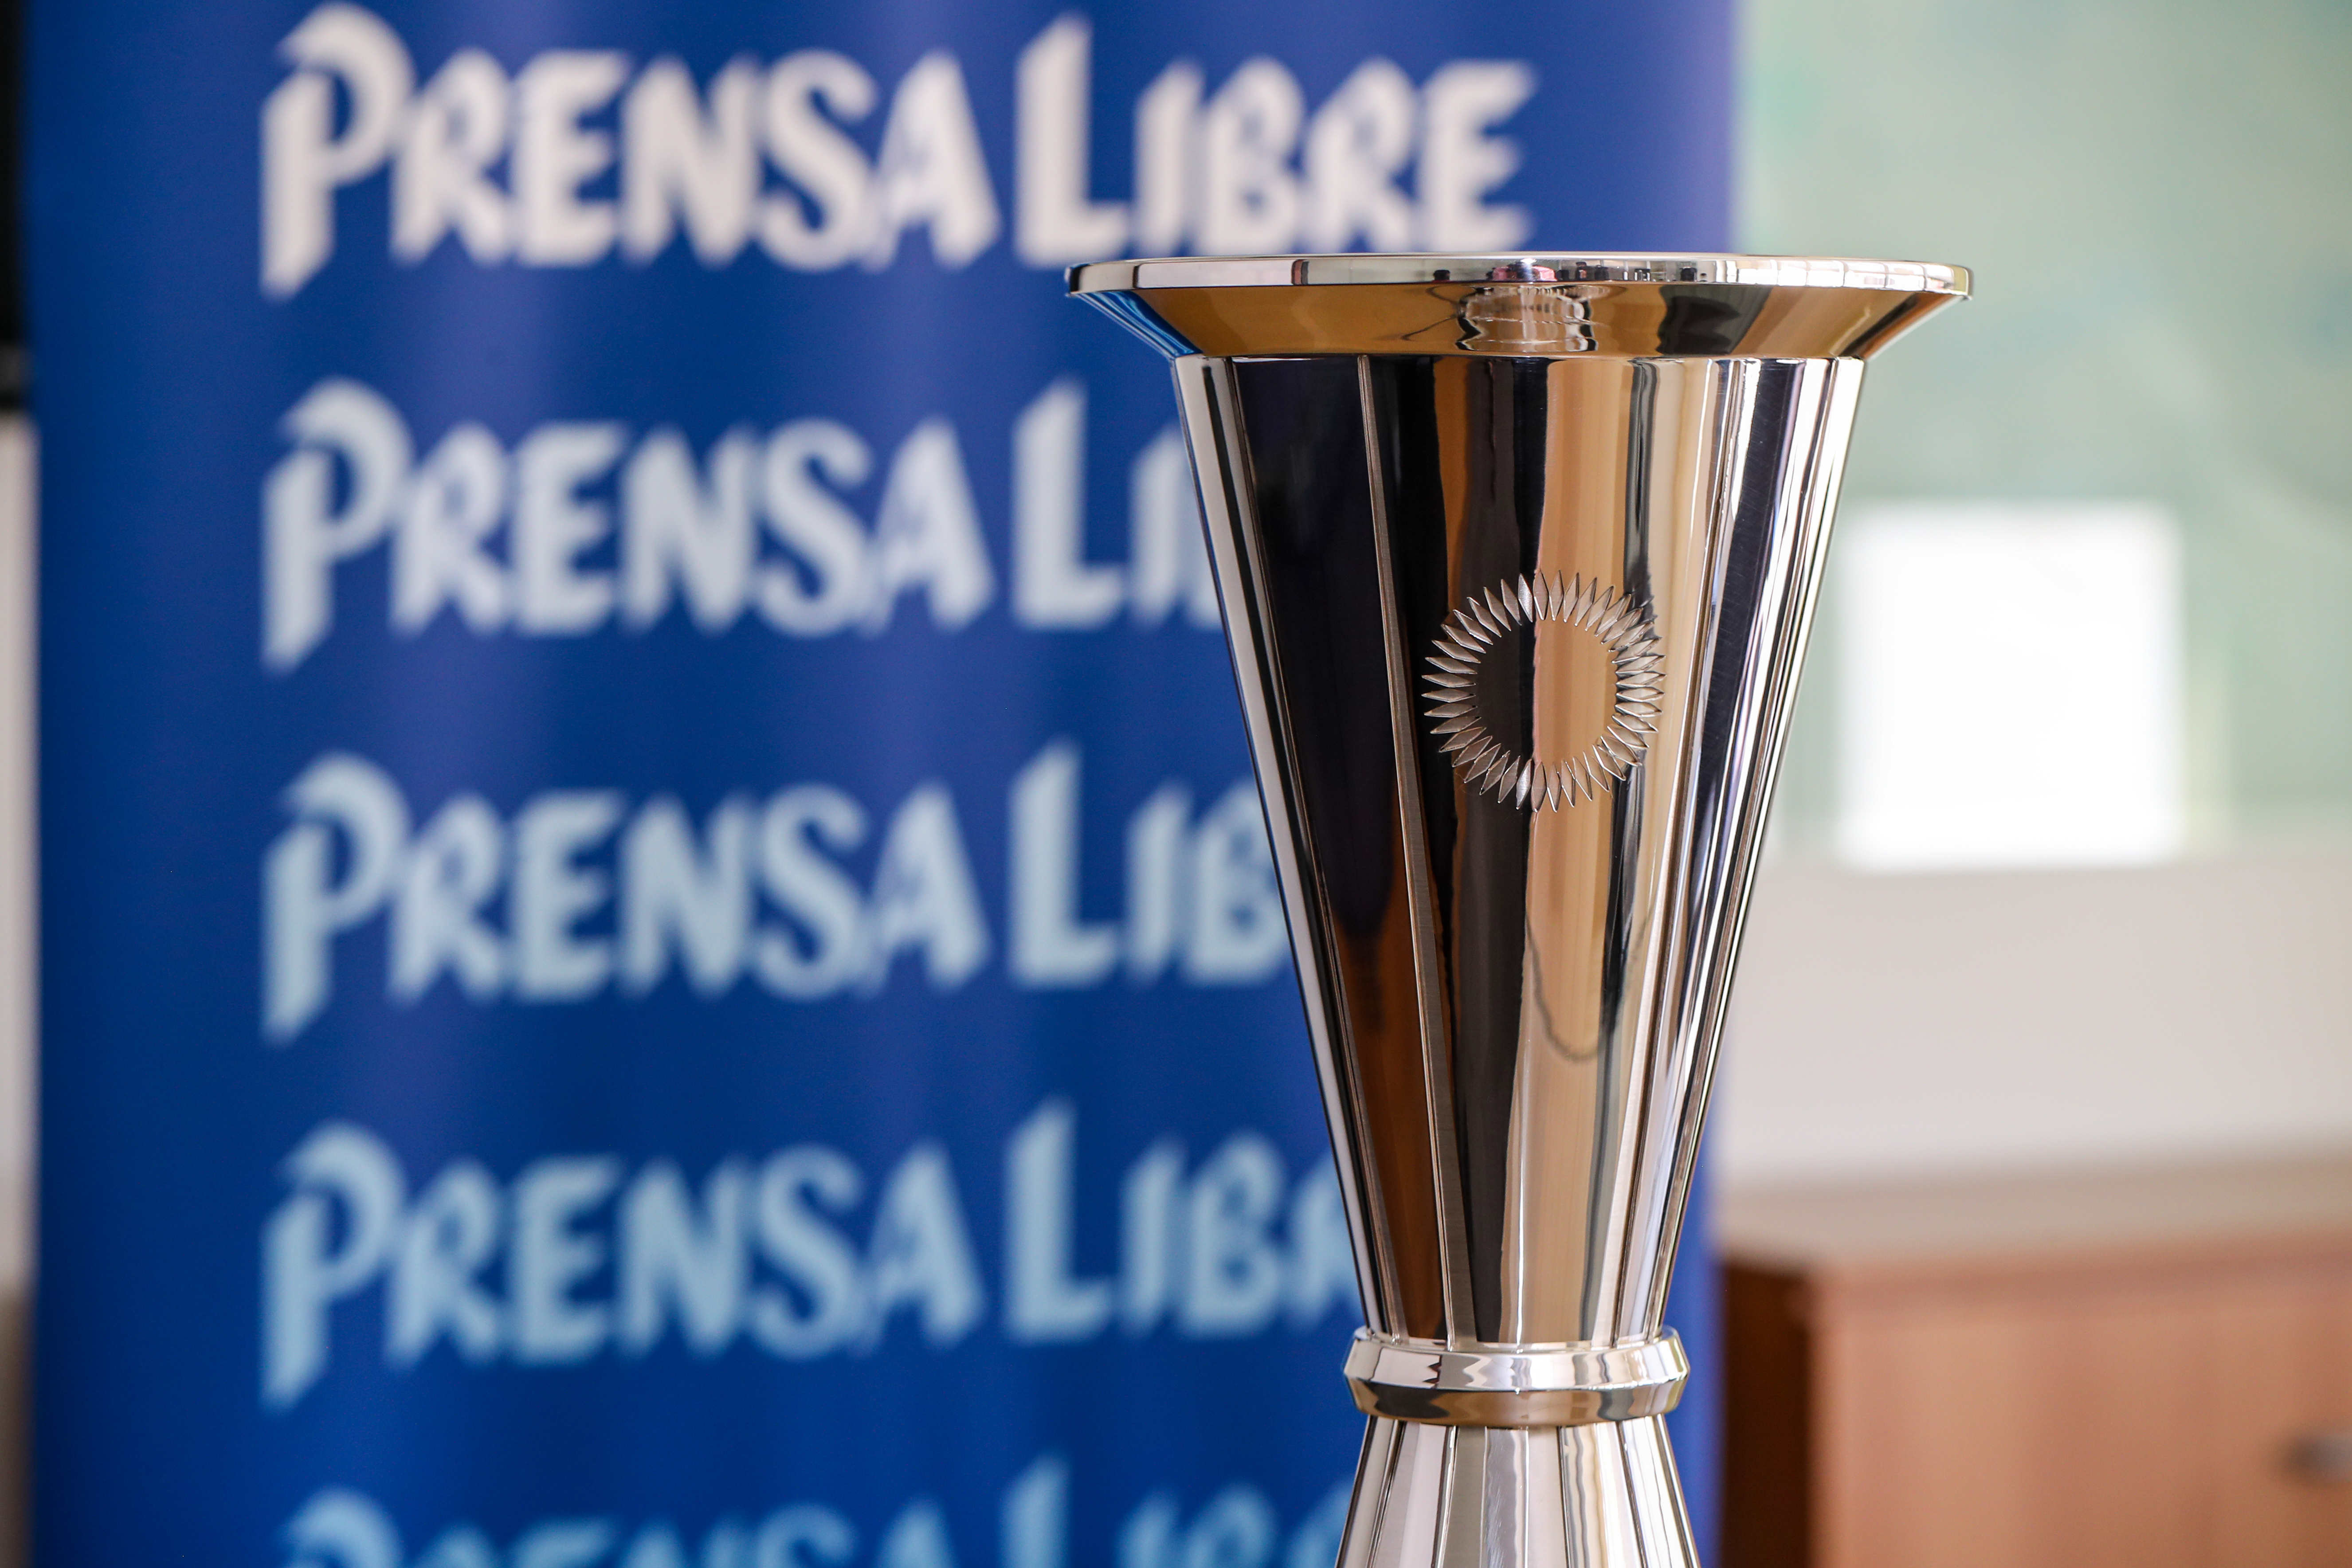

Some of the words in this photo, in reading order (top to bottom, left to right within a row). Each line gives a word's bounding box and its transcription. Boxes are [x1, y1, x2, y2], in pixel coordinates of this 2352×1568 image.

[261, 4, 1000, 295] PRENSA
[1014, 19, 1533, 265] LIBRE
[263, 381, 995, 670] PRENSA
[263, 754, 989, 1039] PRENSA
[1009, 744, 1291, 986] LIB
[263, 1124, 982, 1404] PRENSA
[1006, 1107, 1363, 1337] LIB
